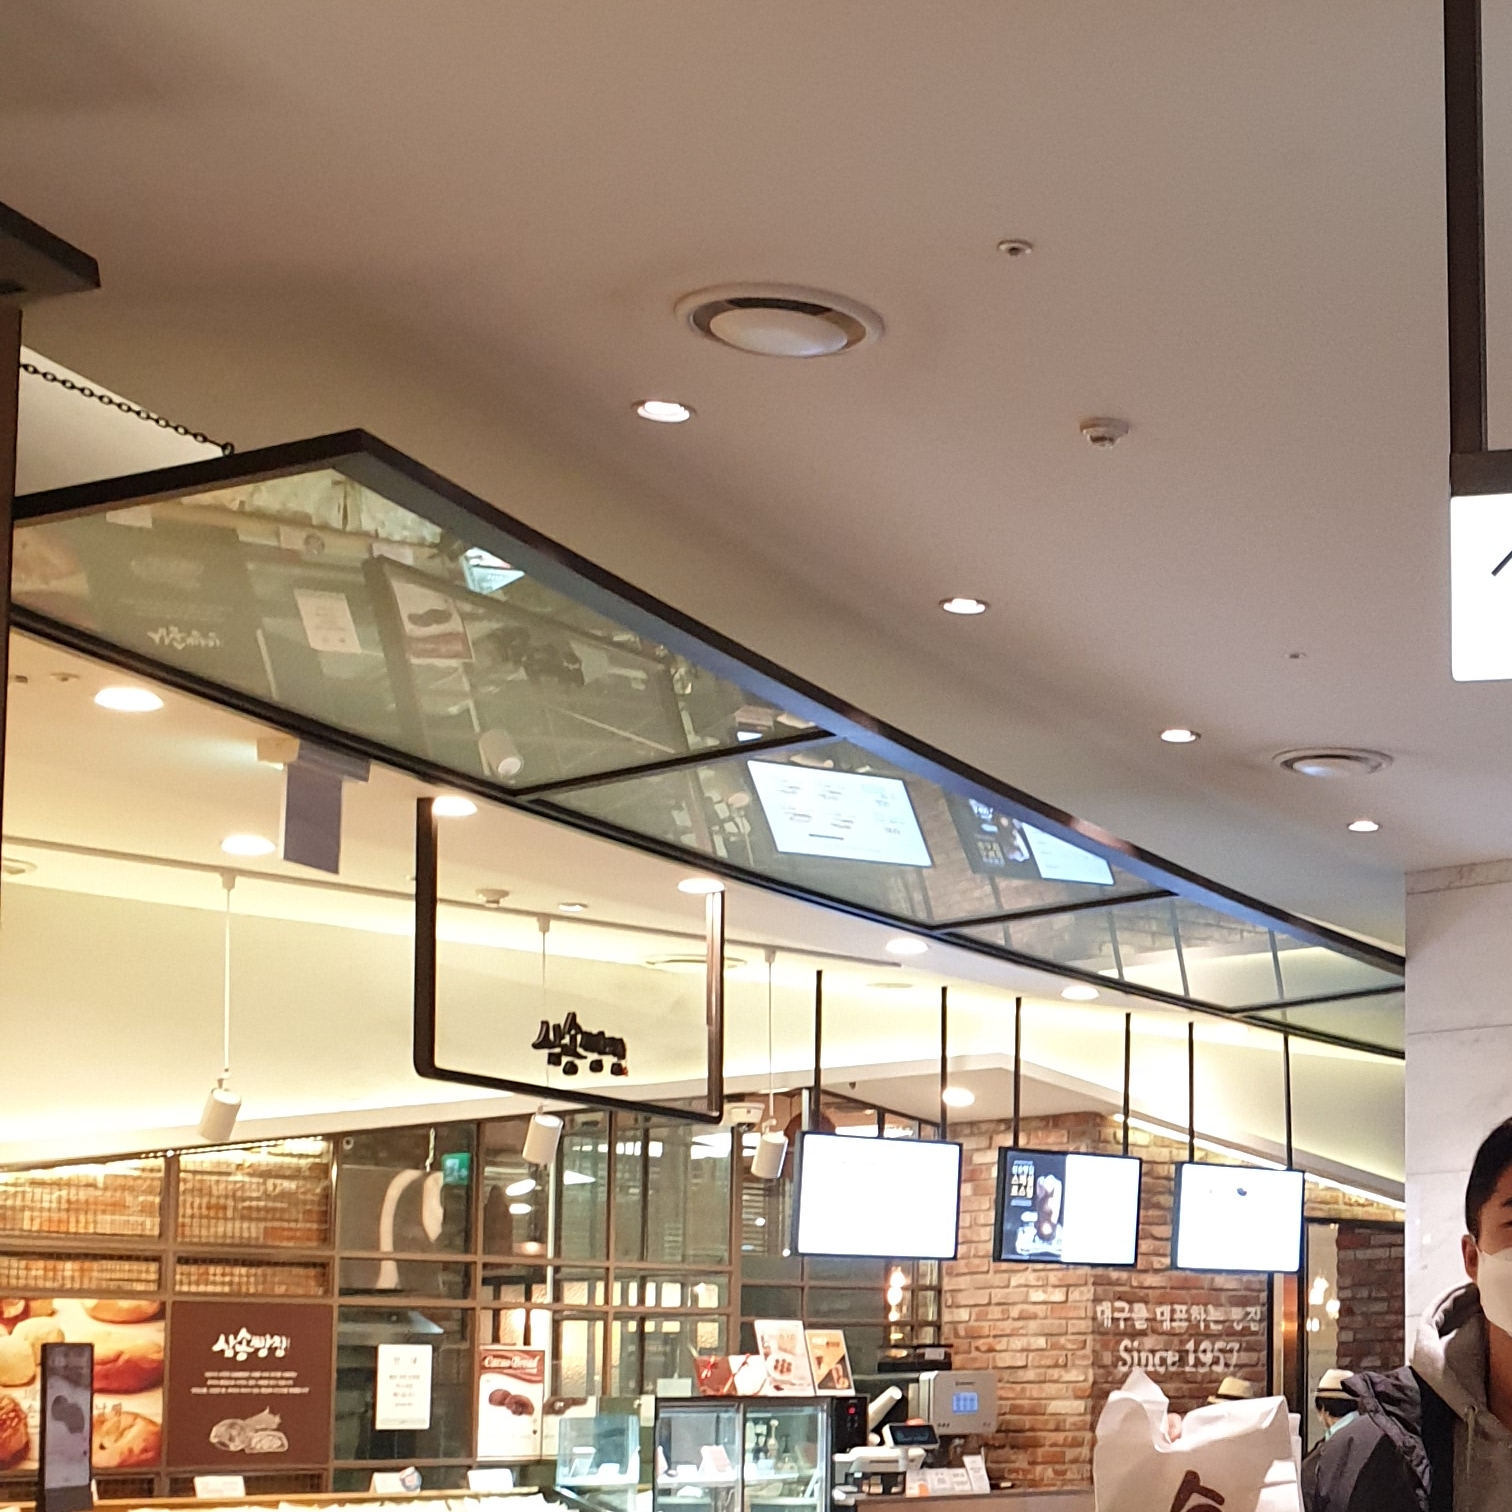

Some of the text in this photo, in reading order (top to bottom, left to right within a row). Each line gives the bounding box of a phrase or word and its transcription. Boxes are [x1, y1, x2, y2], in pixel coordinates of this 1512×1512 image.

[1096, 1300, 1149, 1330] 대구를
[1118, 1338, 1240, 1374] Since 1957
